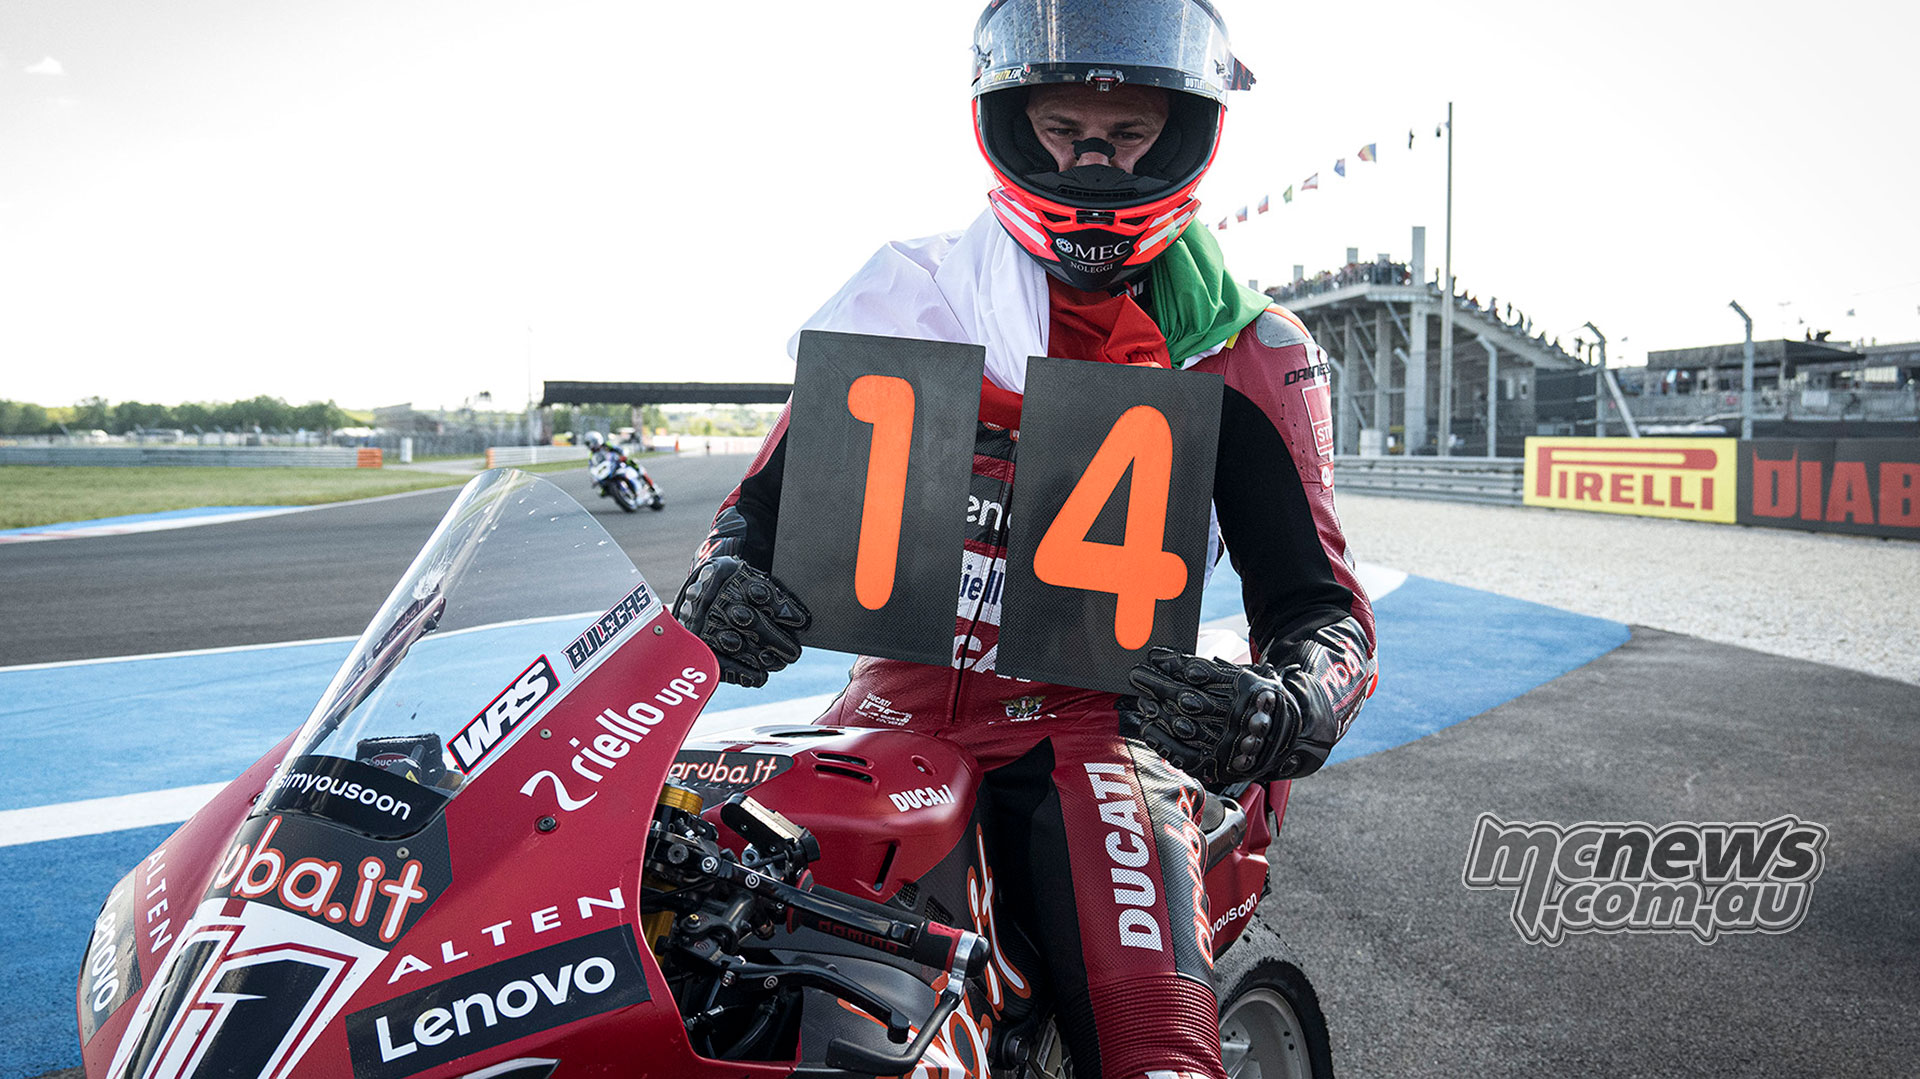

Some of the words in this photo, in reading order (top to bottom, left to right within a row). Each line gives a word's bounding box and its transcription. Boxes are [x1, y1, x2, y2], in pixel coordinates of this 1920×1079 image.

[1070, 261, 1113, 273] NOLEGGI
[1074, 240, 1130, 261] MEC
[847, 374, 915, 610] 1
[1033, 404, 1188, 650] 4
[1536, 446, 1718, 511] PIRELLI
[1752, 446, 1920, 528] DIAB
[564, 583, 652, 671] BULEGAS
[452, 660, 551, 770] WRS
[570, 701, 665, 784] riello
[655, 665, 708, 711] ups
[275, 768, 411, 821] simyousoon
[668, 752, 778, 784] aruba.it
[147, 848, 173, 954] ALTEN
[1084, 762, 1163, 952] DUCATI
[387, 886, 626, 985] ALTEN
[1210, 892, 1258, 941] yousoon
[375, 956, 616, 1063] Lenovo
